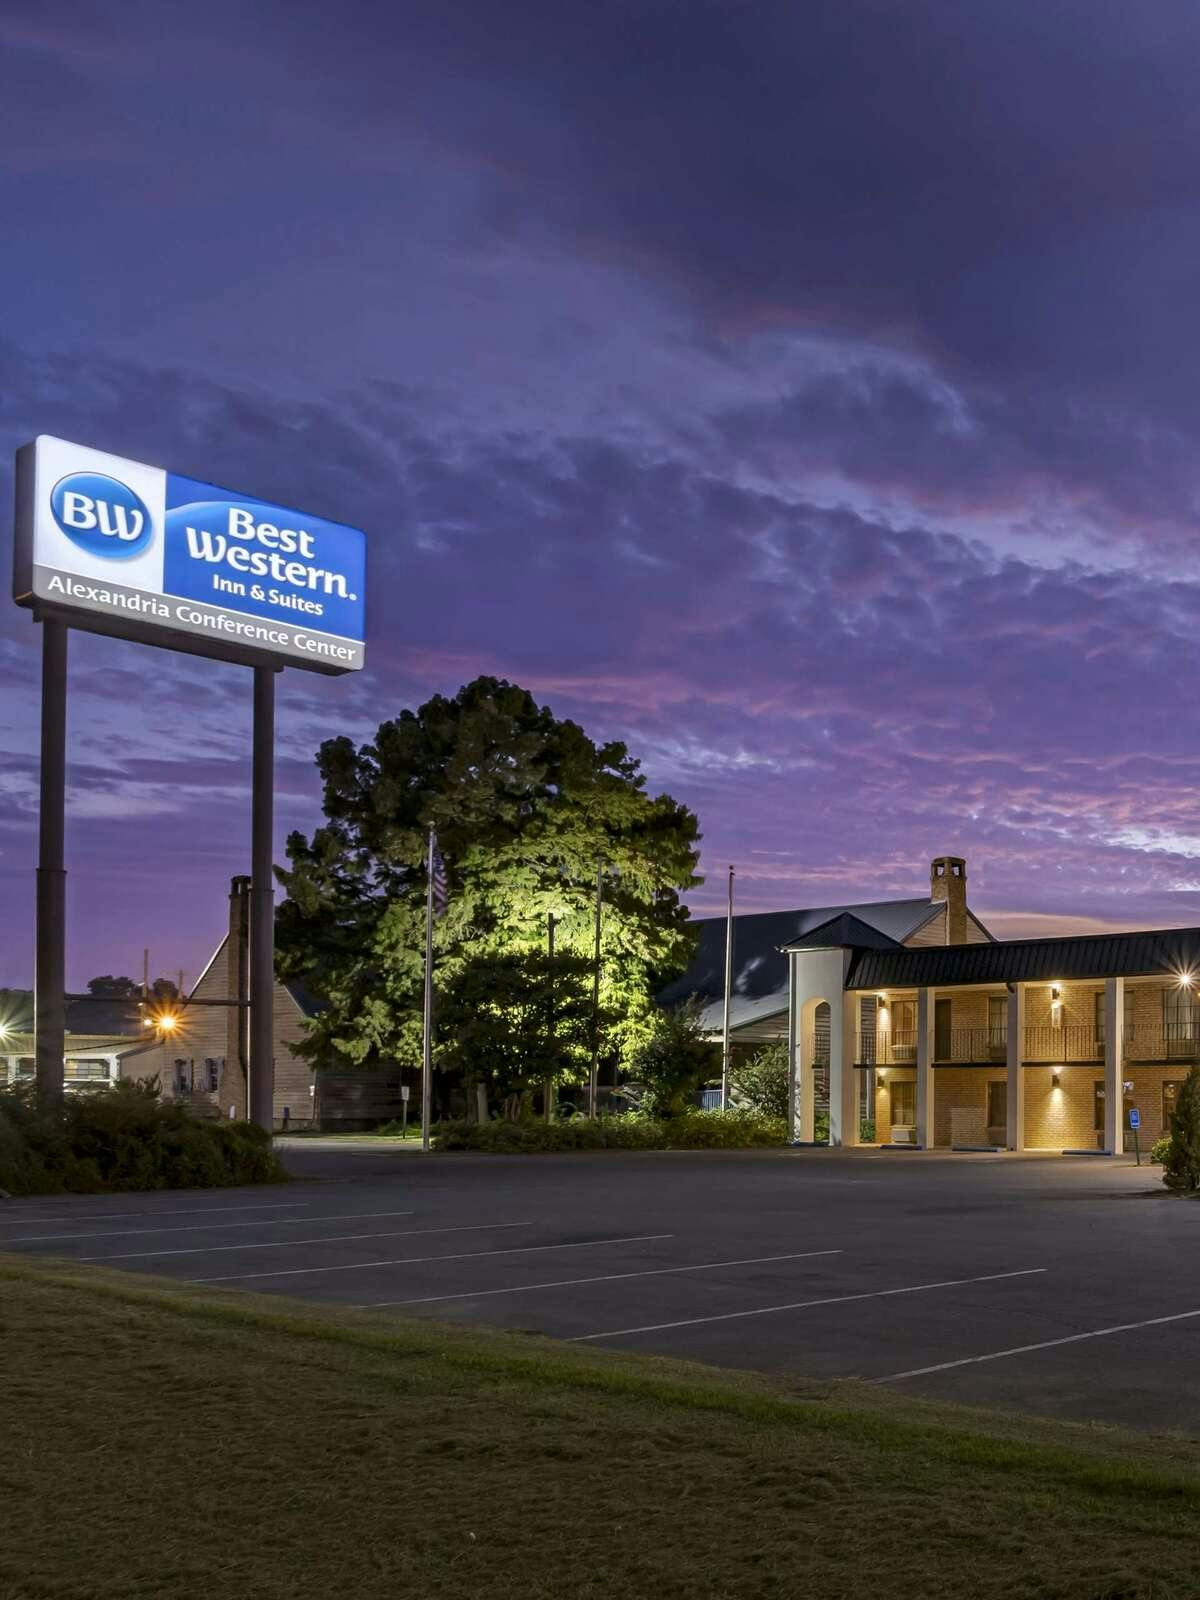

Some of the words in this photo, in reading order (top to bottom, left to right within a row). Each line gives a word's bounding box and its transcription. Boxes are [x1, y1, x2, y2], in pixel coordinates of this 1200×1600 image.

[63, 491, 144, 541] BW
[228, 507, 316, 559] Best
[47, 575, 170, 618] Alexandria
[176, 605, 289, 646] Conference
[294, 634, 356, 661] Center
[212, 573, 246, 597] Inn
[249, 584, 266, 602] &
[268, 589, 324, 616] Suites
